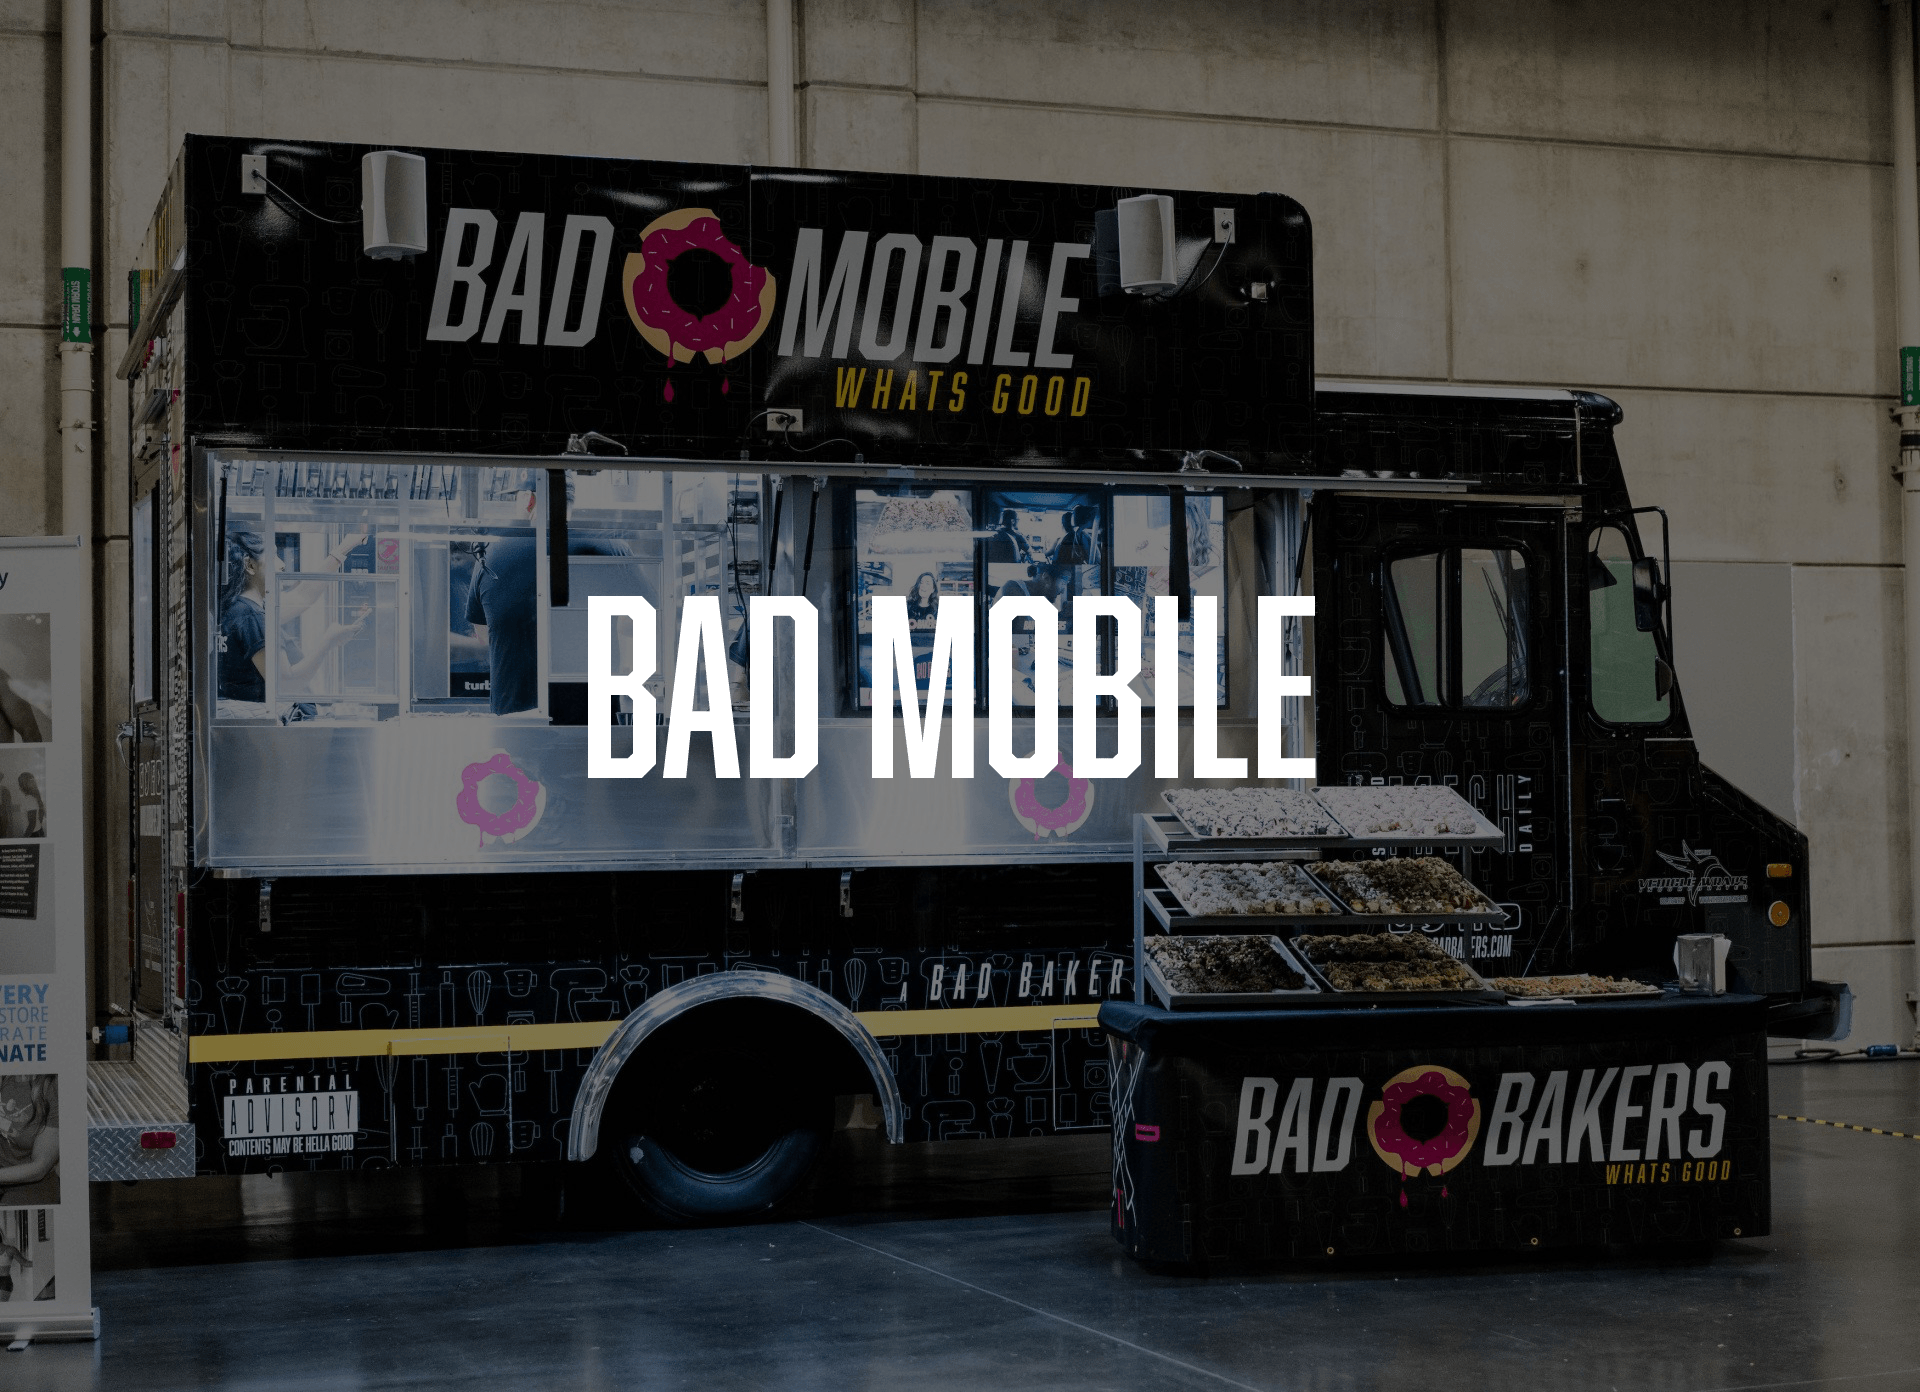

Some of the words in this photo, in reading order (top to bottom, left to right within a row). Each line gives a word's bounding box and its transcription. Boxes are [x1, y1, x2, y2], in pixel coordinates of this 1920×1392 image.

[71, 281, 81, 303] STORM
[426, 207, 615, 348] BAD
[777, 227, 1091, 369] MOBILE
[836, 366, 968, 412] WHATS
[991, 373, 1091, 417] GOOD
[1518, 775, 1533, 852] DAILY
[1432, 935, 1513, 959] ADBAERS.COM
[0, 984, 49, 1004] ERY
[898, 981, 908, 1002] A
[929, 963, 992, 1001] BAD
[1018, 958, 1135, 998] BAKER
[229, 1074, 352, 1094] PARENTAL
[230, 1094, 352, 1135] ADVISORY
[1231, 1076, 1365, 1175] BAD
[1483, 1060, 1733, 1167] BAKERS
[228, 1138, 271, 1156] CONTENTS
[272, 1137, 291, 1154] MAY
[292, 1136, 304, 1153] BE
[305, 1135, 330, 1153] HELLA
[331, 1134, 354, 1151] GOOD
[1605, 1162, 1671, 1185] WHATS
[1681, 1160, 1732, 1182] GOOD
